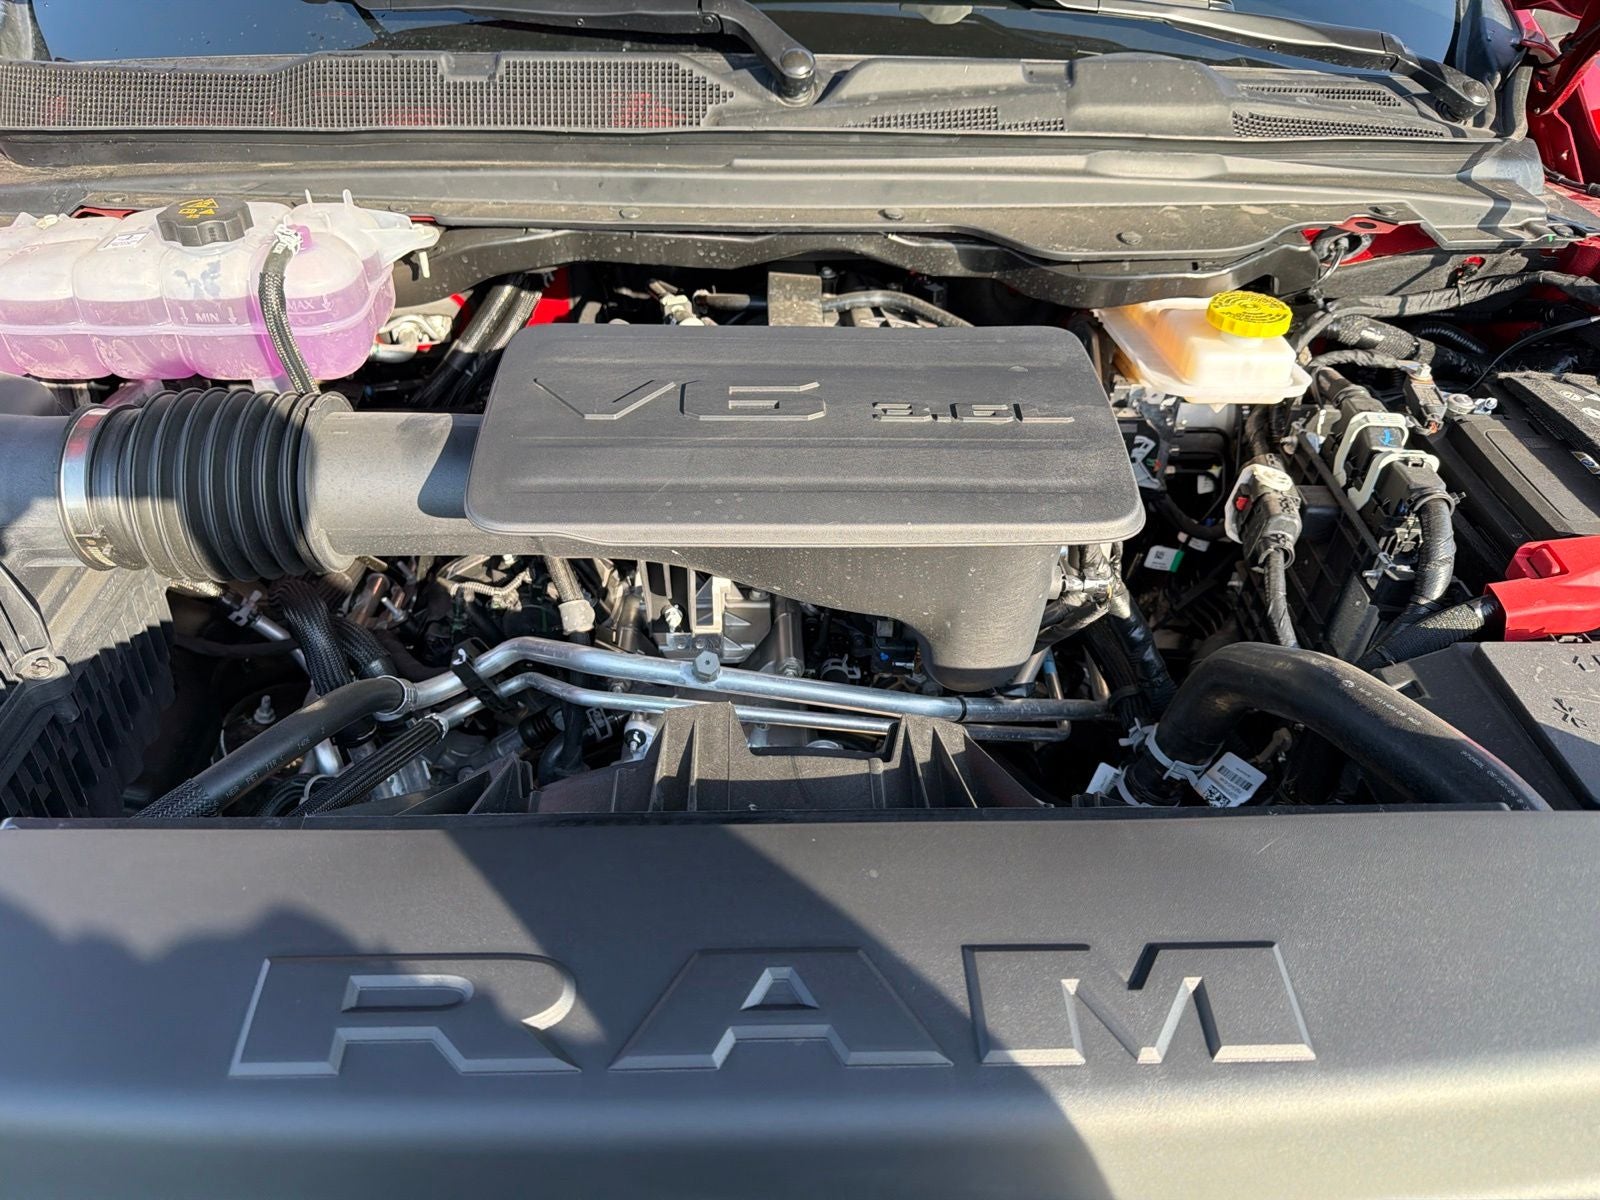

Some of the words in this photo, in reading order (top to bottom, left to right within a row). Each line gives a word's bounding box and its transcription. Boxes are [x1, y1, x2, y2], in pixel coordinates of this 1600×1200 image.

[195, 312, 219, 322] MIN
[286, 301, 313, 311] MAX
[533, 376, 827, 421] V6
[872, 401, 1075, 424] 3.6L
[227, 940, 1318, 1078] RAM
